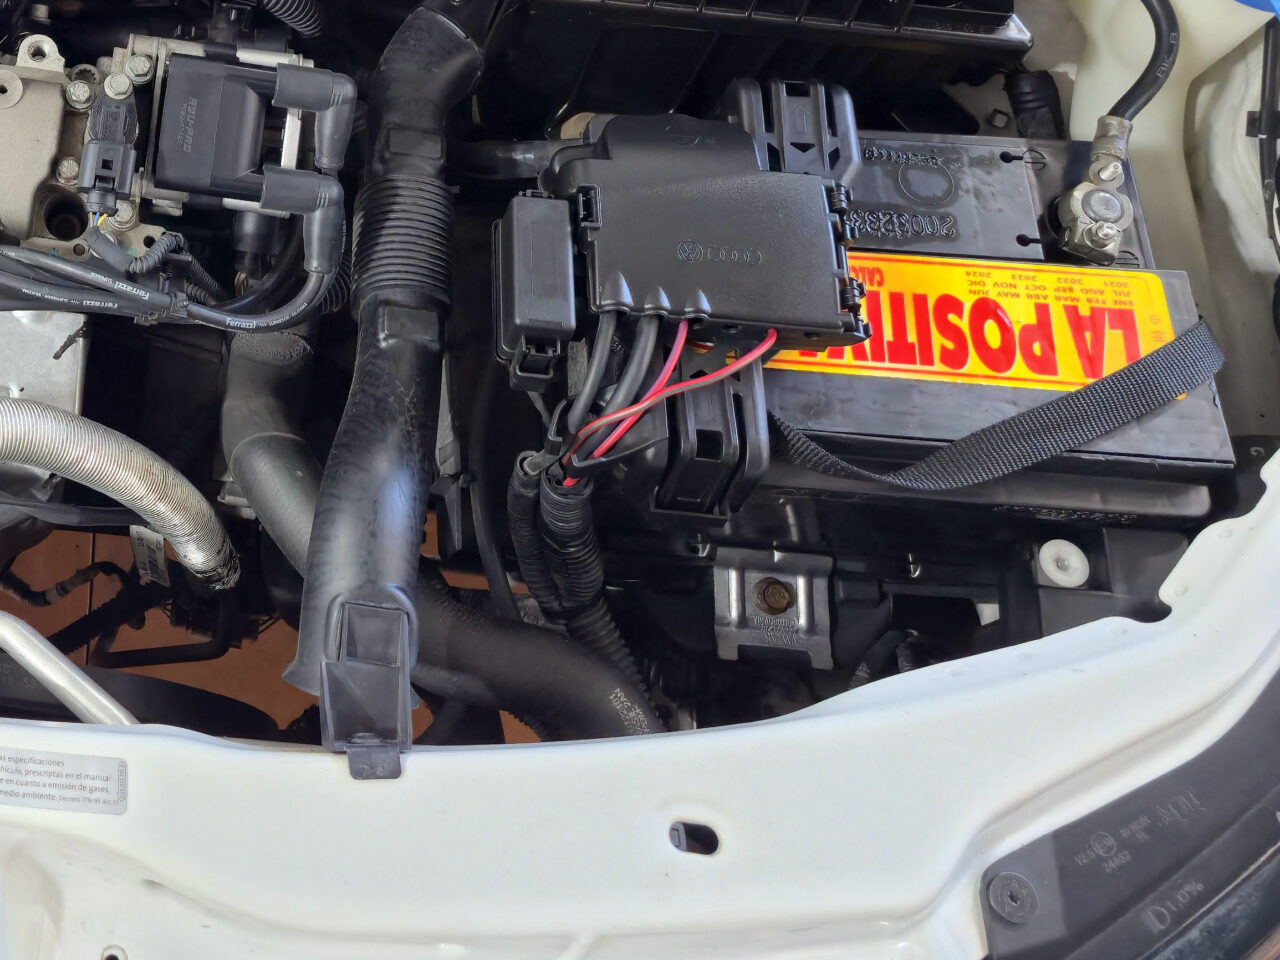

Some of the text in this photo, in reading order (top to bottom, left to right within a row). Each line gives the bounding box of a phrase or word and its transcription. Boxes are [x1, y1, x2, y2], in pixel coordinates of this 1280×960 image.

[965, 270, 991, 279] 2024
[1011, 273, 1037, 282] 2023
[967, 279, 986, 287] DIC
[1056, 276, 1083, 285] 2022
[993, 281, 1017, 290] NOV
[1054, 286, 1074, 294] SEP
[114, 280, 150, 301] Ferrazzi
[1080, 287, 1104, 295] AGO
[1112, 290, 1131, 298] JUL
[969, 288, 1134, 307] ENE FEB MAR ABR MAY JUN
[82, 299, 118, 309] Ferrazzi
[226, 316, 256, 329] Ferrazzi
[1062, 303, 1141, 380] LA
[7, 755, 65, 767] especificaciones
[24, 768, 64, 779] prescriptas
[75, 772, 83, 780] el
[5, 776, 15, 784] en
[15, 779, 41, 788] cuanto
